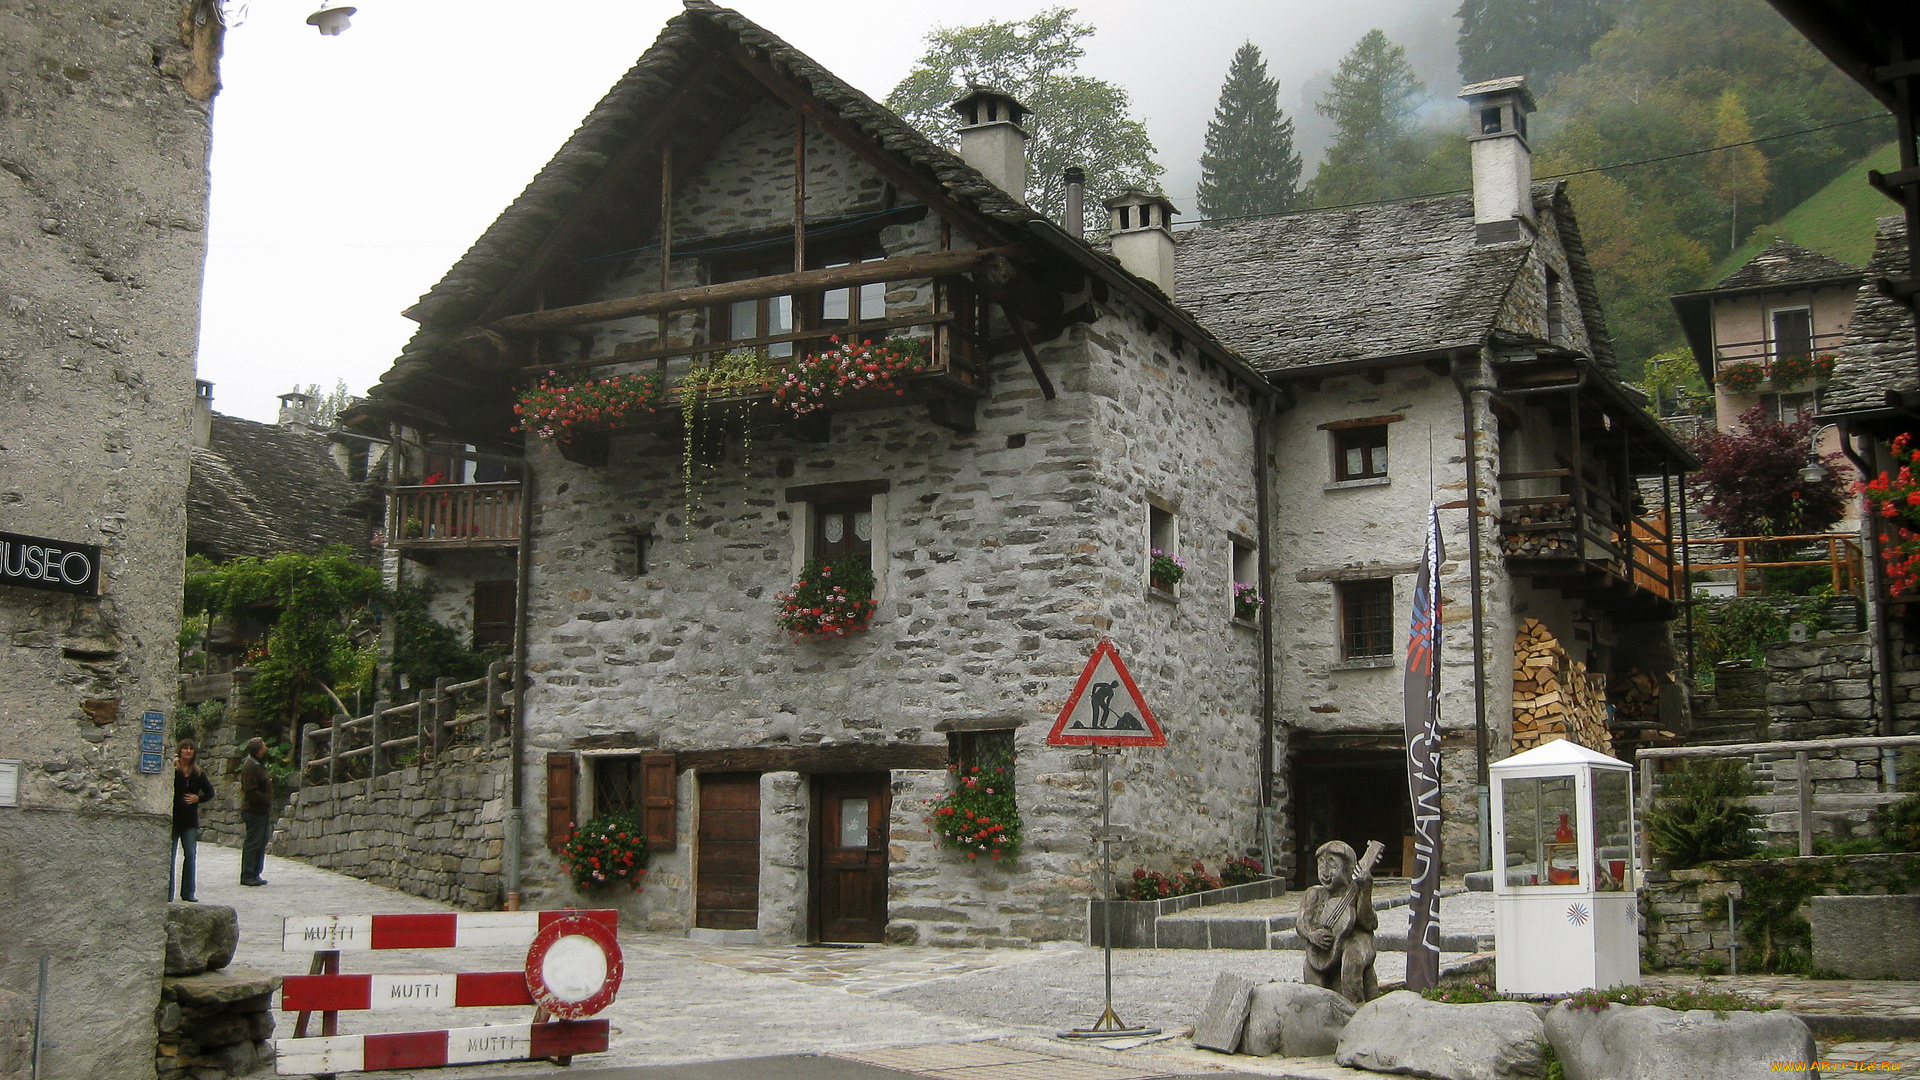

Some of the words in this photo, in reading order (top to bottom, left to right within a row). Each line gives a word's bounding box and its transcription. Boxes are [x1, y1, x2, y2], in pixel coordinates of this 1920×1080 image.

[304, 925, 354, 941] MUTTI
[391, 984, 439, 998] MUTTI
[468, 1035, 514, 1052] MUTTI
